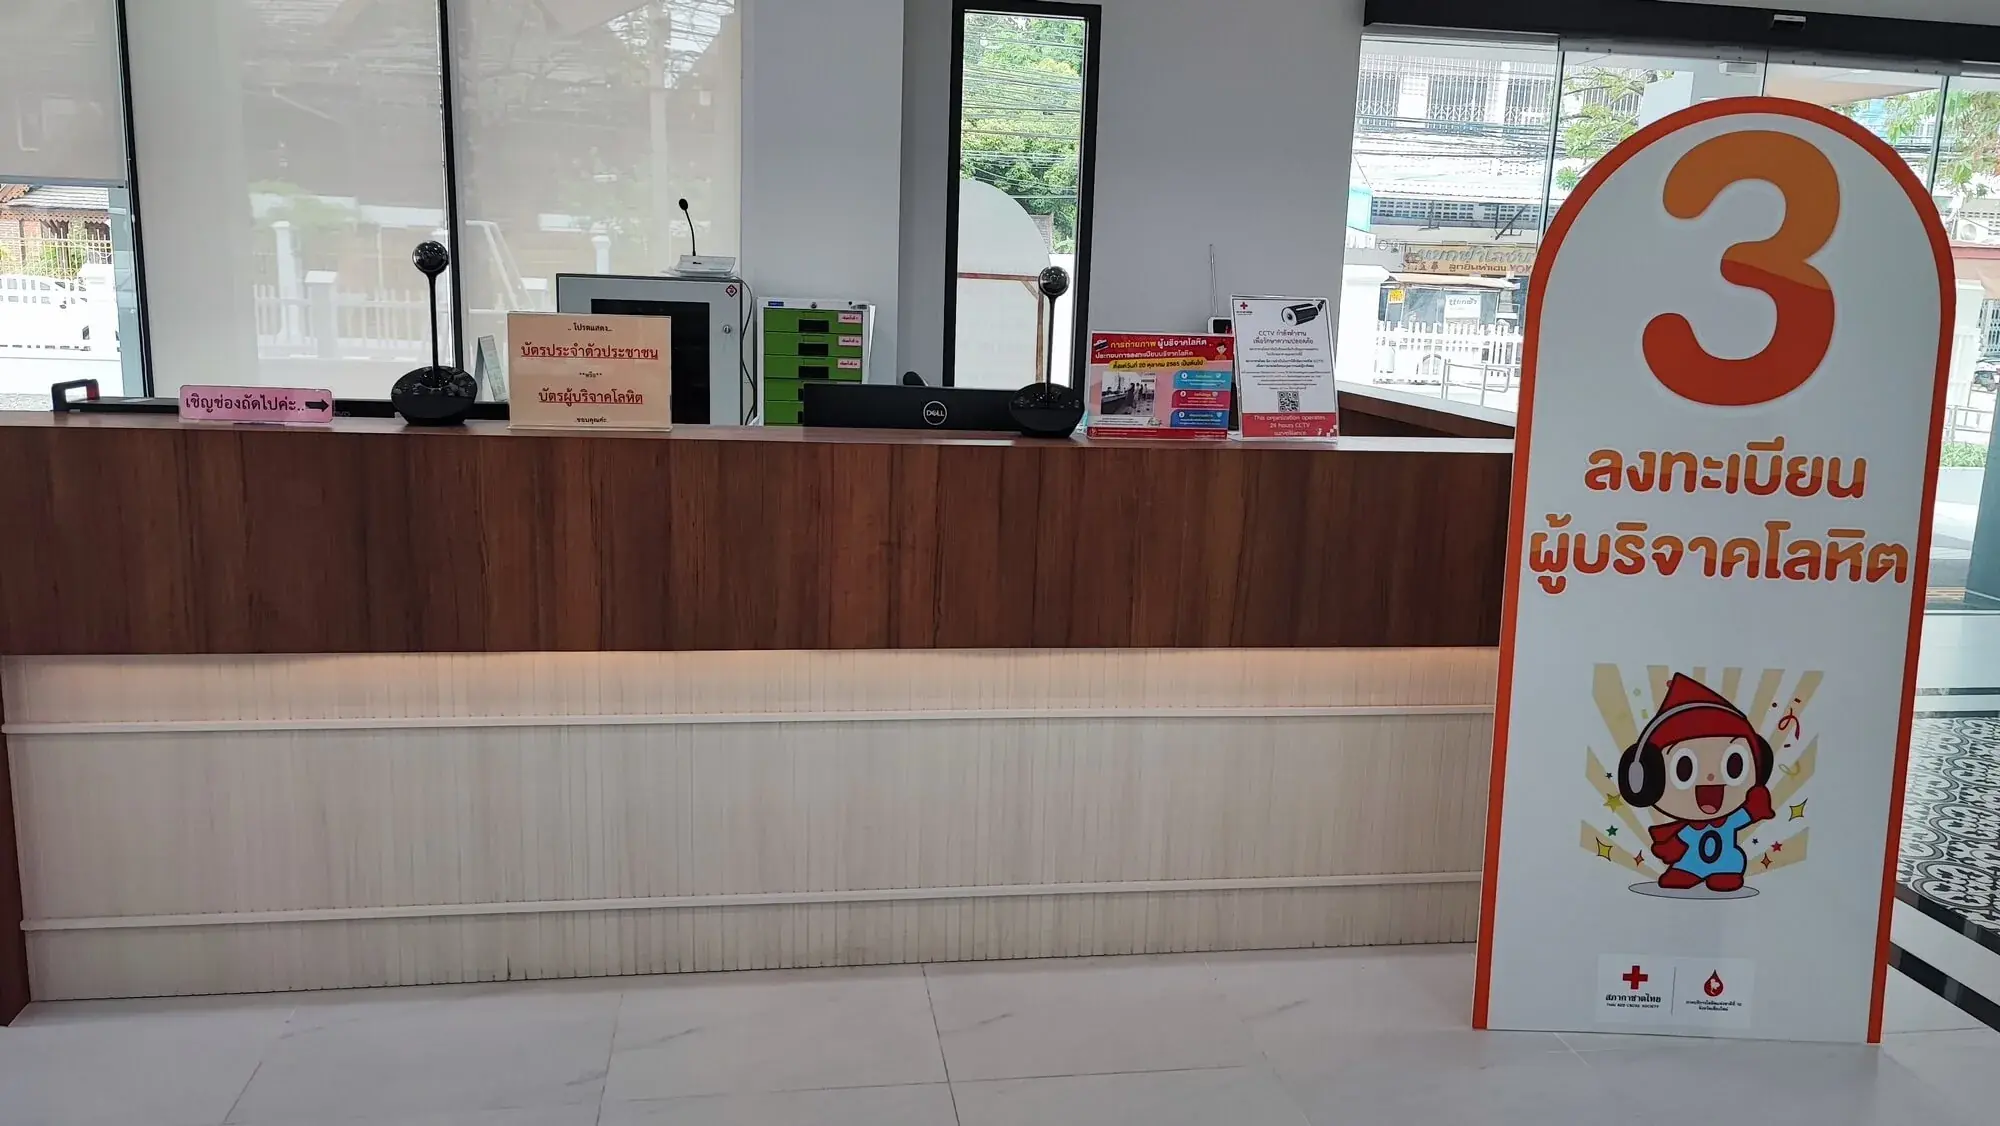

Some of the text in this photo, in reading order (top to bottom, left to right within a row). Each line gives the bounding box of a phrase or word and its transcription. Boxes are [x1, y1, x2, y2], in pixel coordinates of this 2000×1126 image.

[1642, 130, 1841, 406] 3
[521, 342, 658, 360] บัตรประจำตัวประชาชน
[538, 387, 643, 407] บัตรผู้บริจาคโลหิต
[926, 409, 945, 417] DELL
[1585, 436, 1866, 498] ลงทะเบียน
[1529, 513, 1909, 595] ผู้บริจาคโลหิต
[1605, 993, 1661, 1003] สภากาชาดไทย
